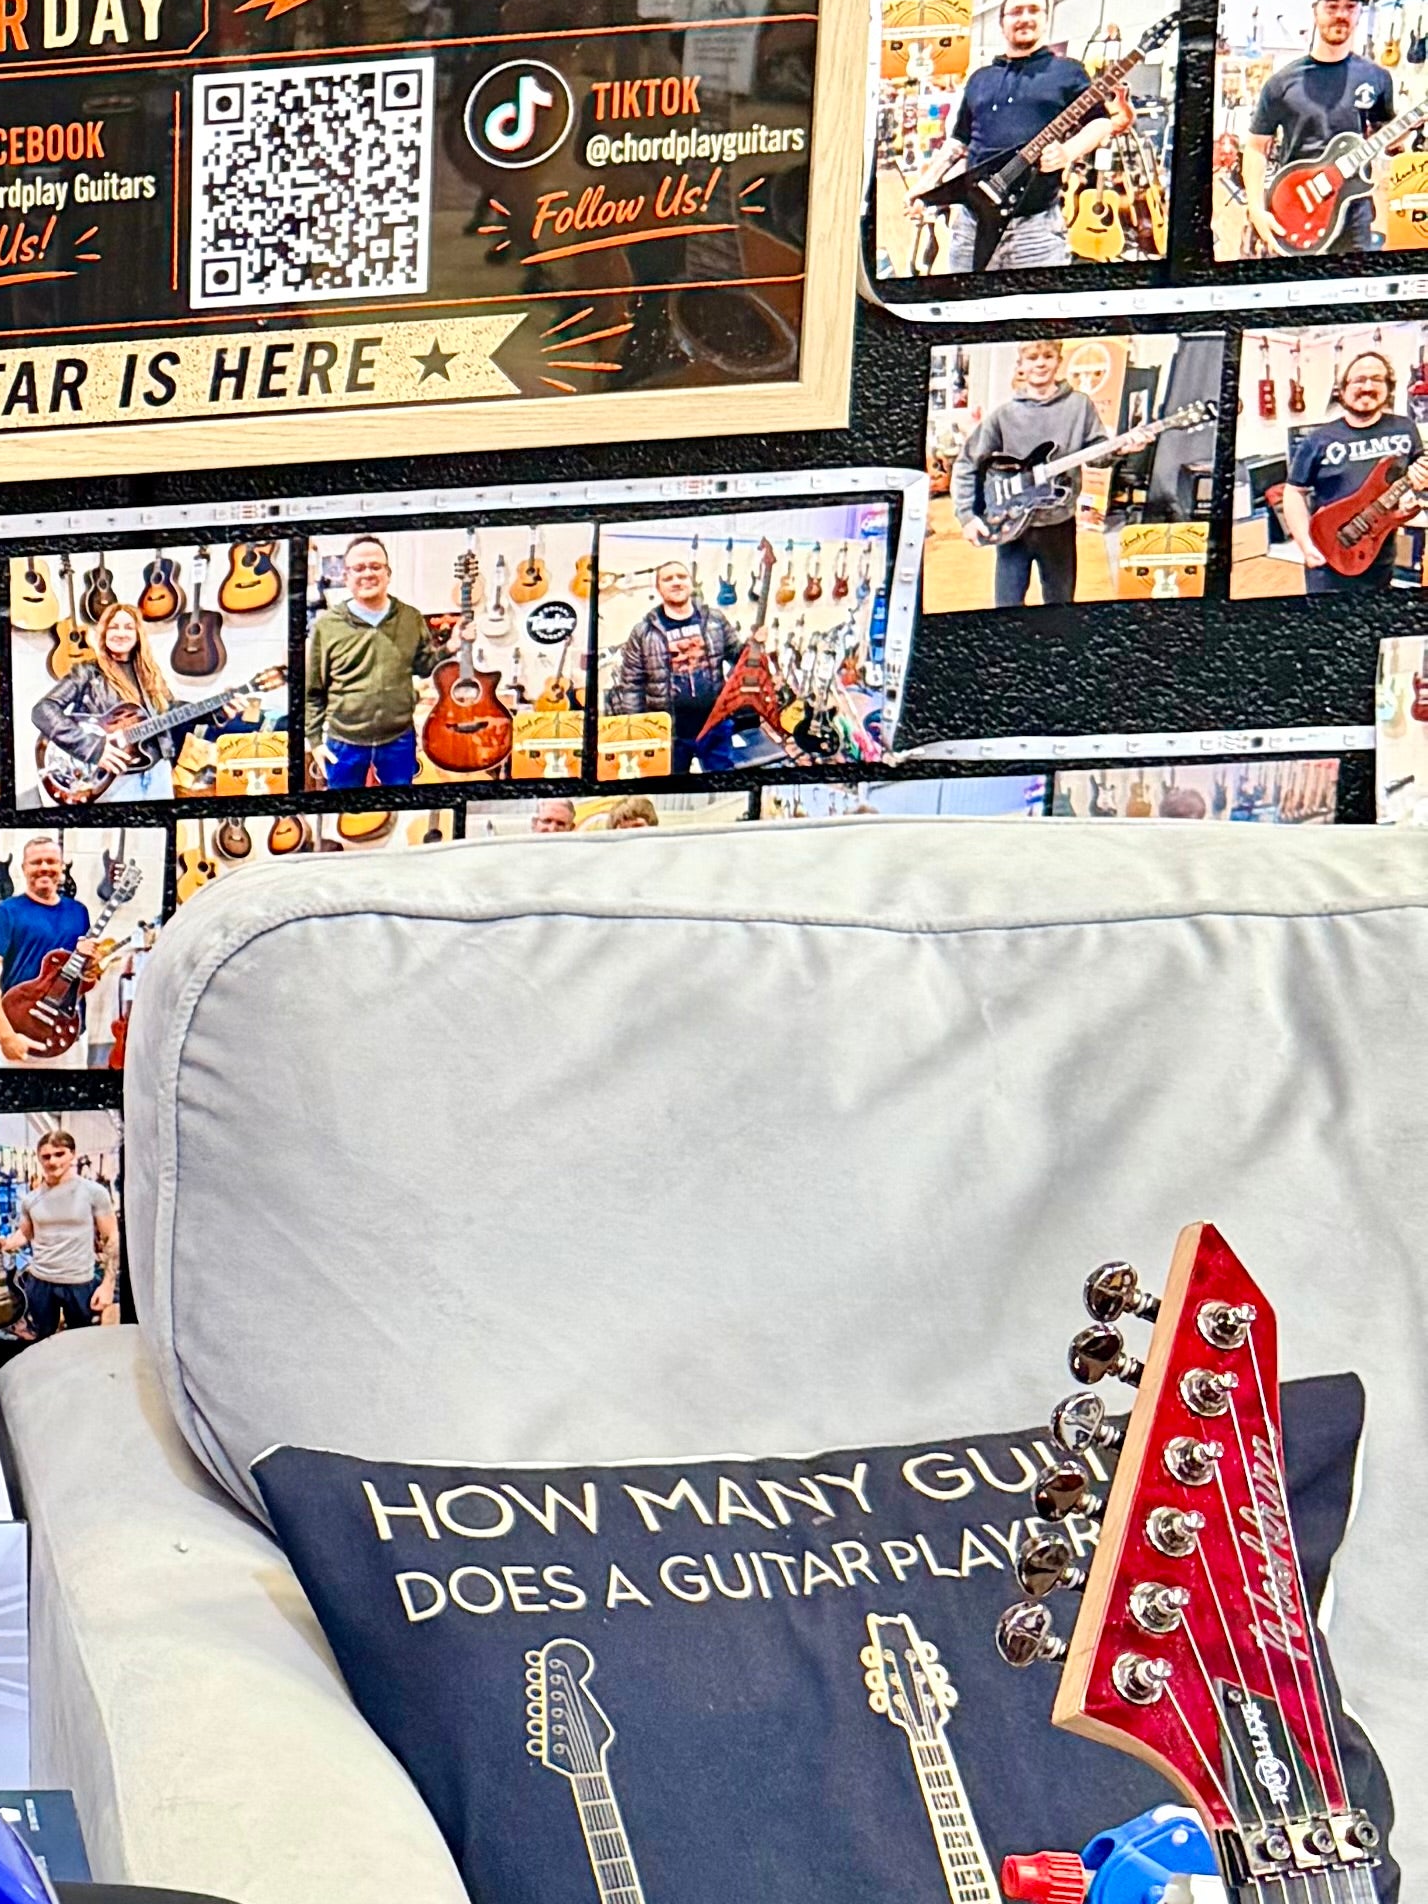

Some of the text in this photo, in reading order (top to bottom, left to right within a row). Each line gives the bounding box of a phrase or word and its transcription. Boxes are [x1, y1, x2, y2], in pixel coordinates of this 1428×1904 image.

[591, 77, 701, 121] TIKTOK
[585, 123, 805, 168] @chordplayguitars
[74, 171, 156, 204] Guitars
[533, 168, 721, 238] Follow Us!
[119, 350, 180, 410] IS
[209, 336, 382, 402] HERE
[362, 1479, 598, 1543] HOW
[622, 1462, 873, 1532] MANY
[395, 1565, 588, 1623] DOES
[605, 1566, 652, 1610] A
[659, 1539, 880, 1604] GUITAR
